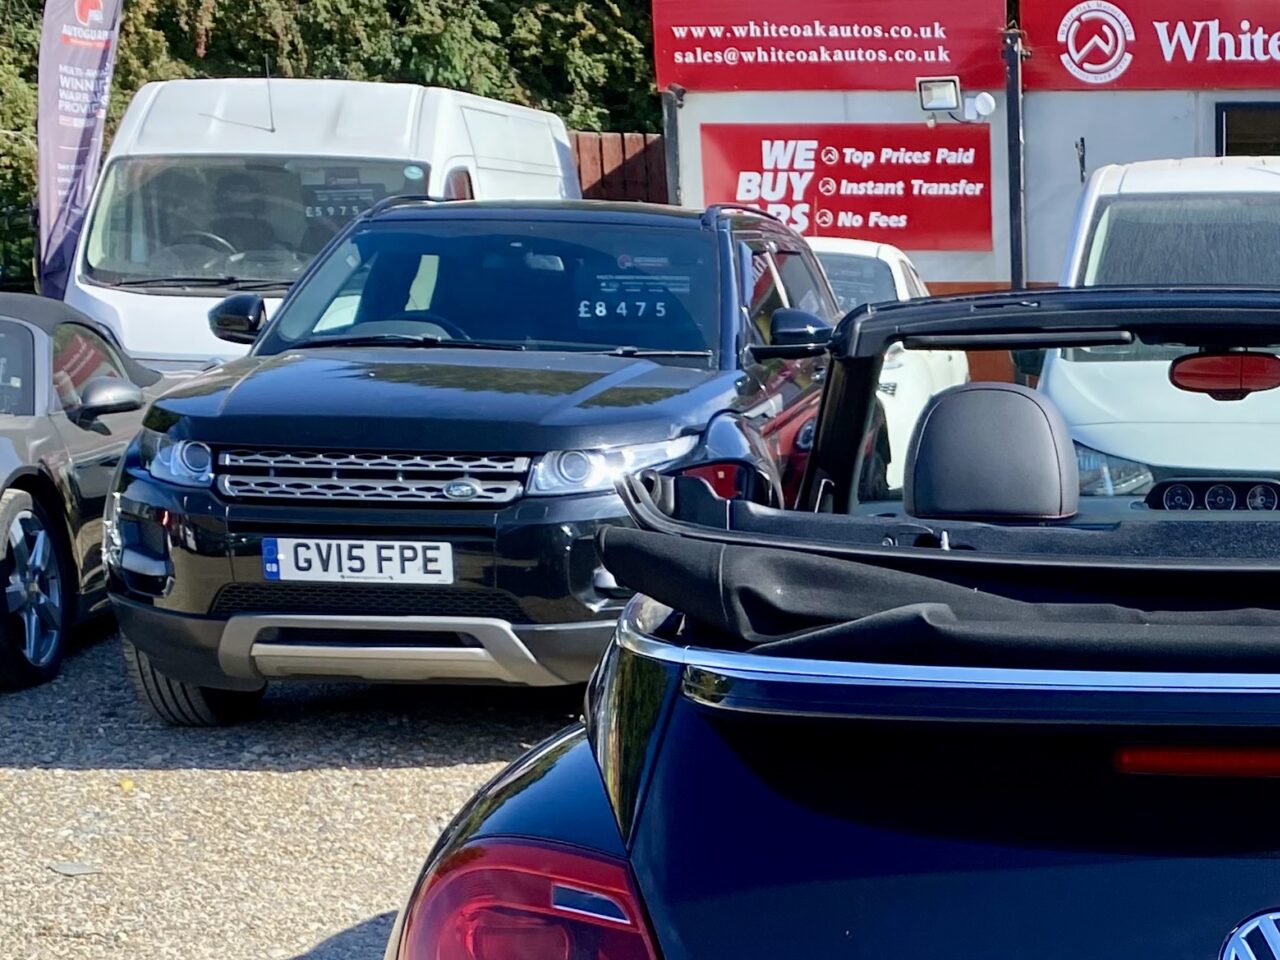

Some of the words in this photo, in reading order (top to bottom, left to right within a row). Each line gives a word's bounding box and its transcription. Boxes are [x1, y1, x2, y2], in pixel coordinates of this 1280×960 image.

[61, 24, 109, 40] AUTOGUAR
[671, 20, 947, 39] www.whiteoakautos.co.uk
[673, 45, 950, 65] sales@whiteoakautos.co.uk
[761, 140, 818, 169] WE
[842, 148, 875, 168] Top
[880, 147, 931, 164] Prices
[935, 147, 976, 164] Paid
[736, 171, 815, 201] BUY
[839, 179, 905, 196] Instant
[911, 179, 984, 196] Transfer
[305, 205, 359, 218] £5975
[837, 211, 863, 227] No
[868, 211, 908, 228] Fees
[578, 300, 666, 318] £8475
[293, 541, 366, 573] GV15
[376, 543, 442, 575] FPE
